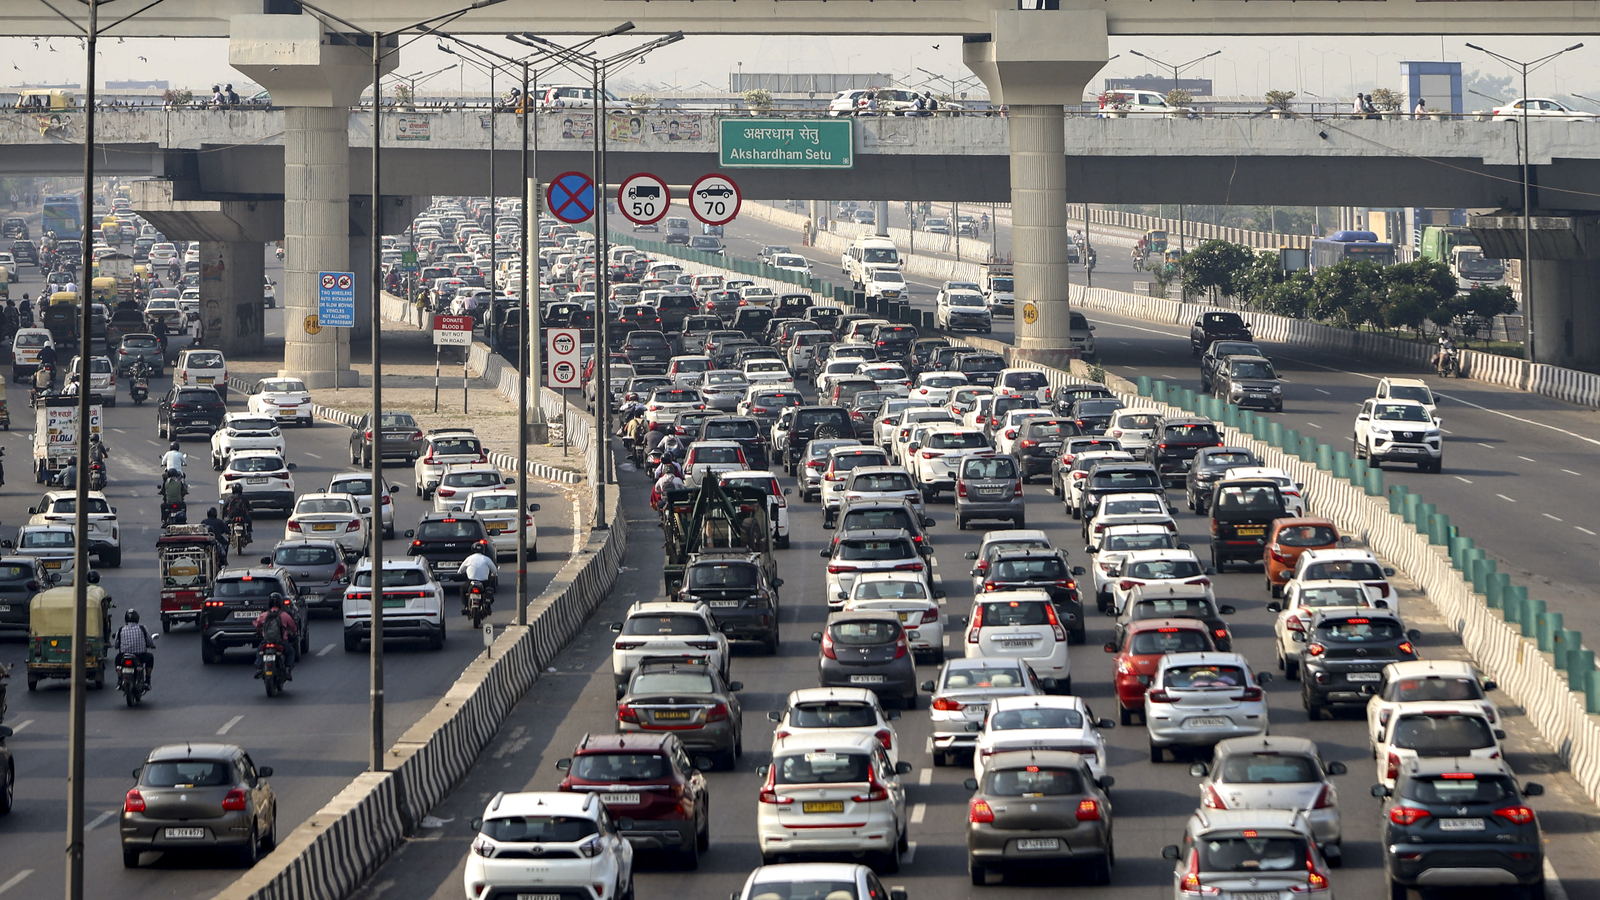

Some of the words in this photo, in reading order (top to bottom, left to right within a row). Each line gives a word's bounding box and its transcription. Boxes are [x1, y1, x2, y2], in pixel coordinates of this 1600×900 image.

[744, 128, 794, 140] अक्षरधाम
[798, 124, 820, 144] सेतु
[730, 148, 802, 160] Akshardham
[806, 149, 832, 160] Setu
[632, 202, 654, 216] 50
[704, 202, 726, 215] 70
[91, 417, 98, 425] C
